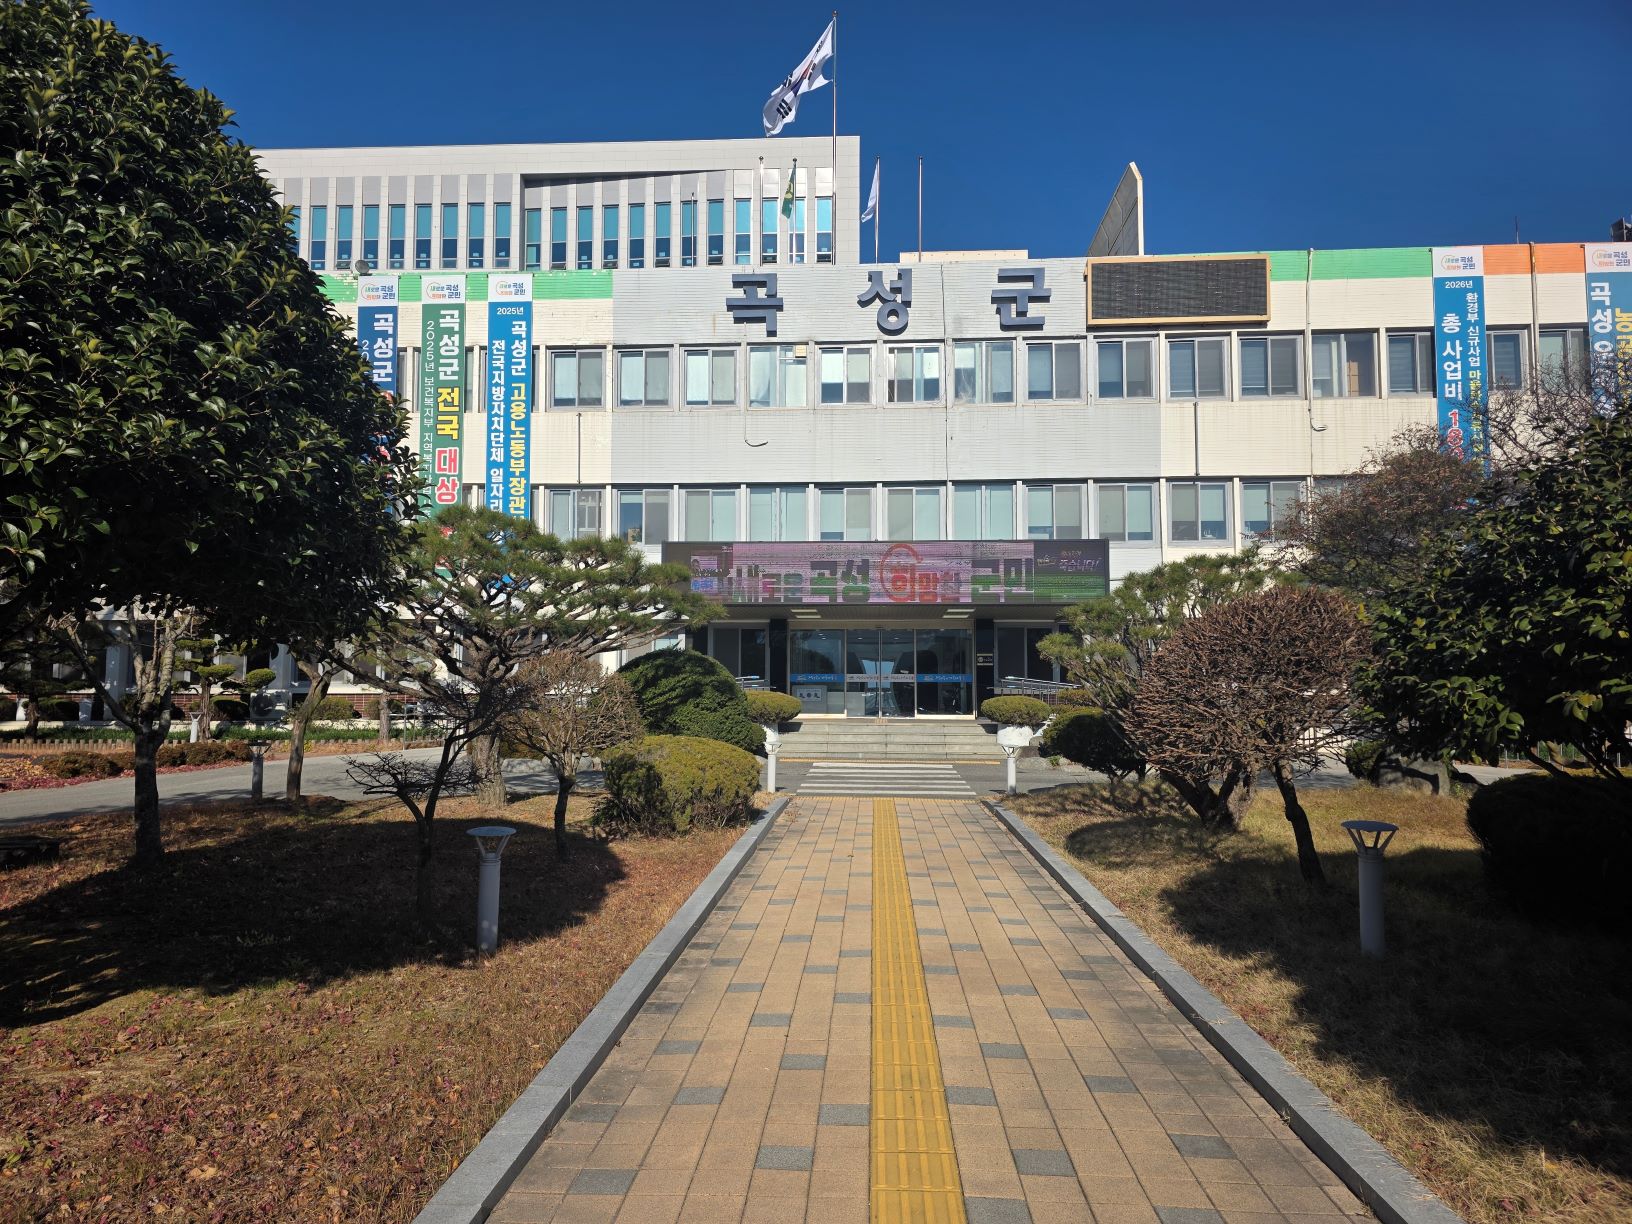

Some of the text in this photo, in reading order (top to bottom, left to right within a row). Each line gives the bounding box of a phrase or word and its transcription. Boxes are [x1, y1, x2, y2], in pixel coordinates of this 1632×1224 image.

[497, 306, 524, 315] 2025년
[1445, 281, 1473, 289] 2026년
[1466, 292, 1479, 323] 환경부
[1590, 282, 1613, 334] 곡성
[372, 313, 394, 382] 곡성군
[424, 321, 435, 372] 2025년
[1441, 313, 1461, 333] 총
[1467, 326, 1480, 367] 신규사업
[1442, 340, 1463, 400] 사업비
[423, 377, 434, 428] 보건복지부
[434, 309, 460, 504] 곡성군 전국 대상
[489, 340, 506, 463] 전국지방자치단체
[508, 321, 527, 520] 곡성군 고용노동부장관
